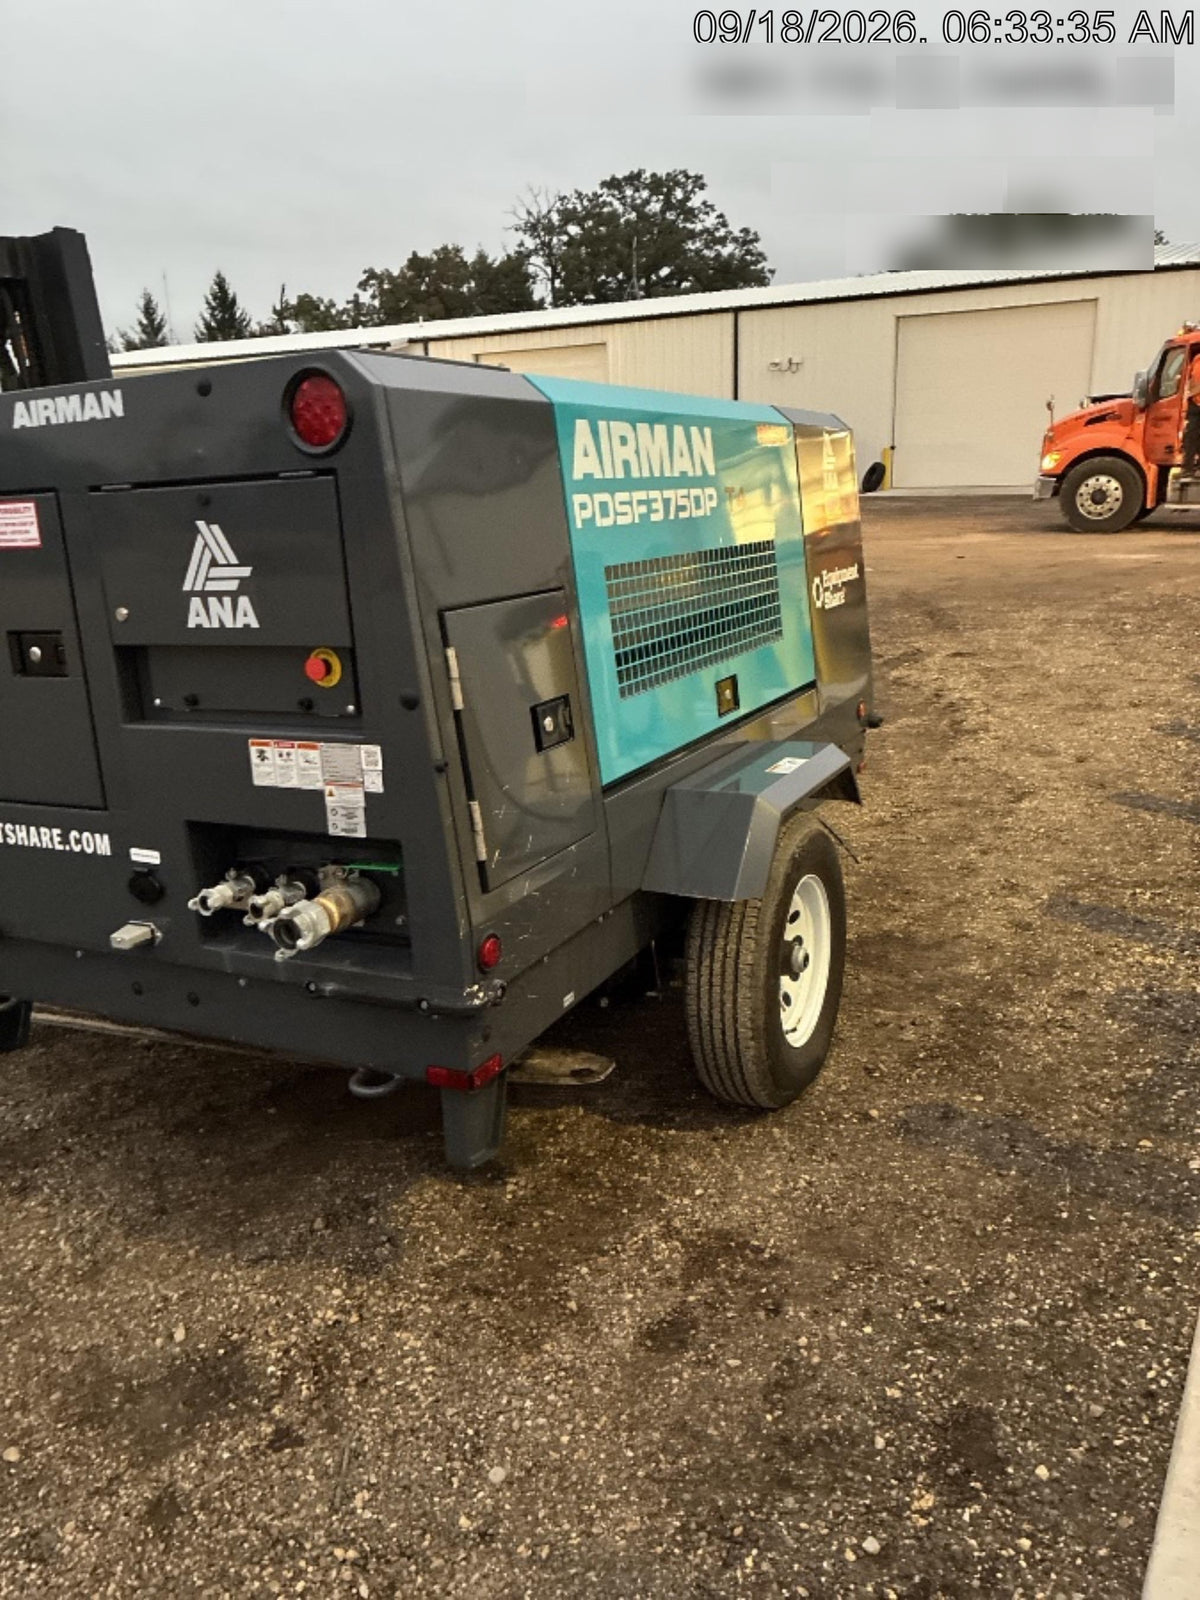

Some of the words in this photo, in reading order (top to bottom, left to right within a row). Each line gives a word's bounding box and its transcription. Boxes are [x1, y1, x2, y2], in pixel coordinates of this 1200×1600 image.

[13, 390, 124, 429] AIRMAN
[573, 419, 716, 480] AIRMAN
[572, 487, 717, 528] PDSF375DP
[187, 596, 260, 628] ANA
